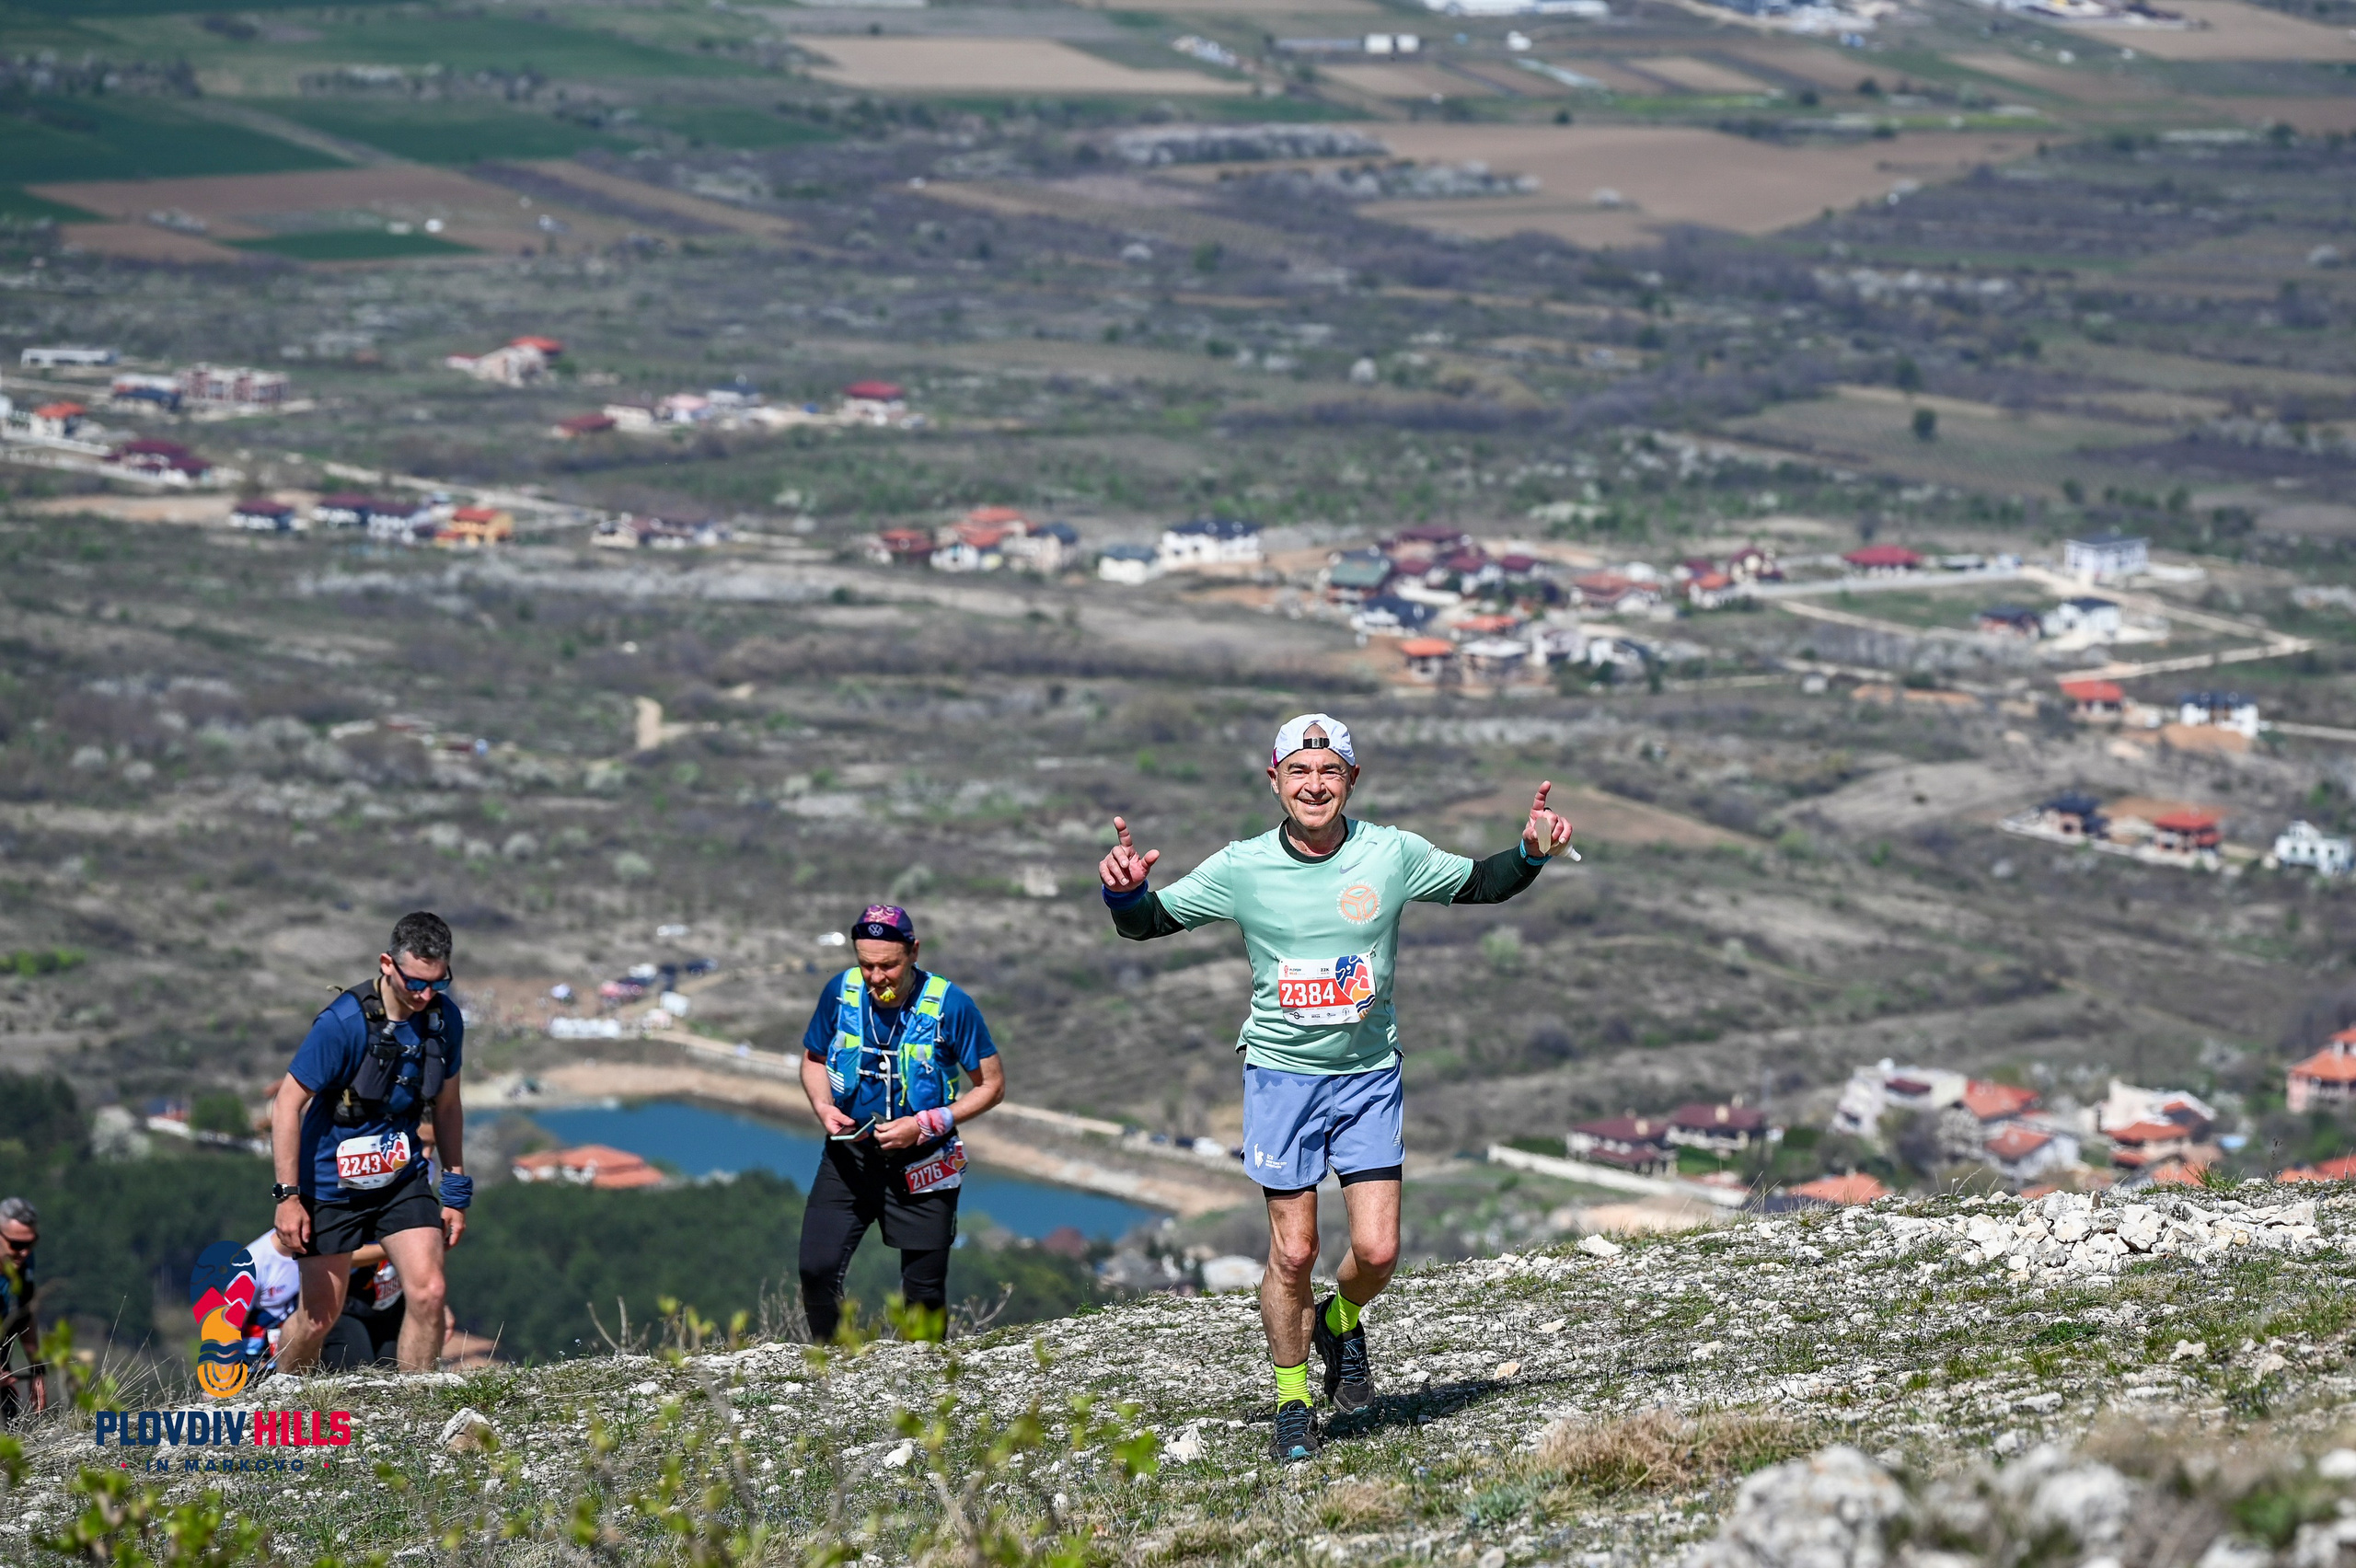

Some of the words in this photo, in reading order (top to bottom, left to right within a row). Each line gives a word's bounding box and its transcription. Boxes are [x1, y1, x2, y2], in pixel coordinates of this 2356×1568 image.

[1281, 982, 1336, 1007] 2384
[340, 1154, 381, 1177] 2243
[910, 1162, 943, 1190] 2176
